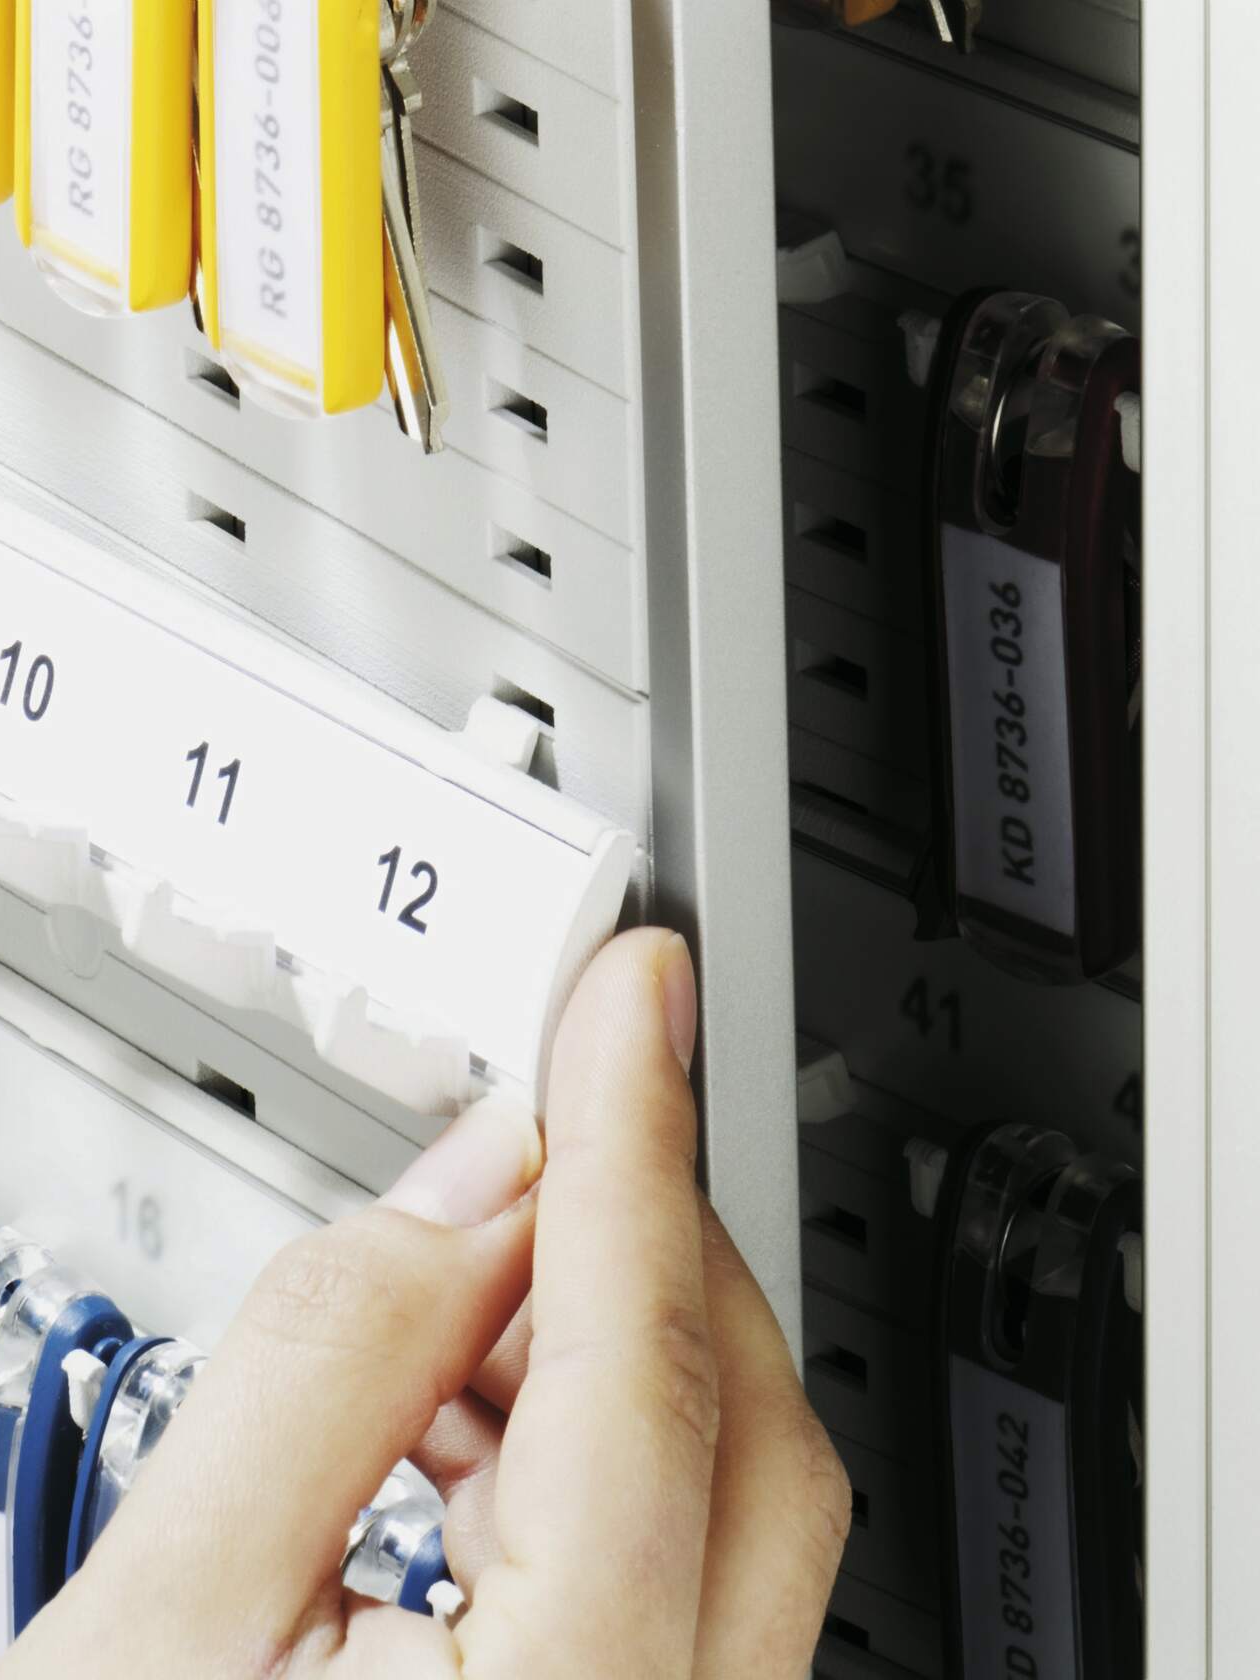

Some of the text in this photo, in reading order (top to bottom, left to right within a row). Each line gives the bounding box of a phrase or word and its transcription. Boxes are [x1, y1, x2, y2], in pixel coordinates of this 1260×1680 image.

[68, 146, 93, 216] RG
[255, 0, 286, 318] RG 8736-006
[904, 140, 976, 227] 35
[0, 640, 54, 721] 10
[988, 581, 1036, 886] KD 8736-036
[187, 742, 240, 824] 11
[379, 846, 437, 934] 12
[900, 976, 961, 1055] 41
[110, 1177, 164, 1262] 16
[996, 1412, 1032, 1635] 8736-042
